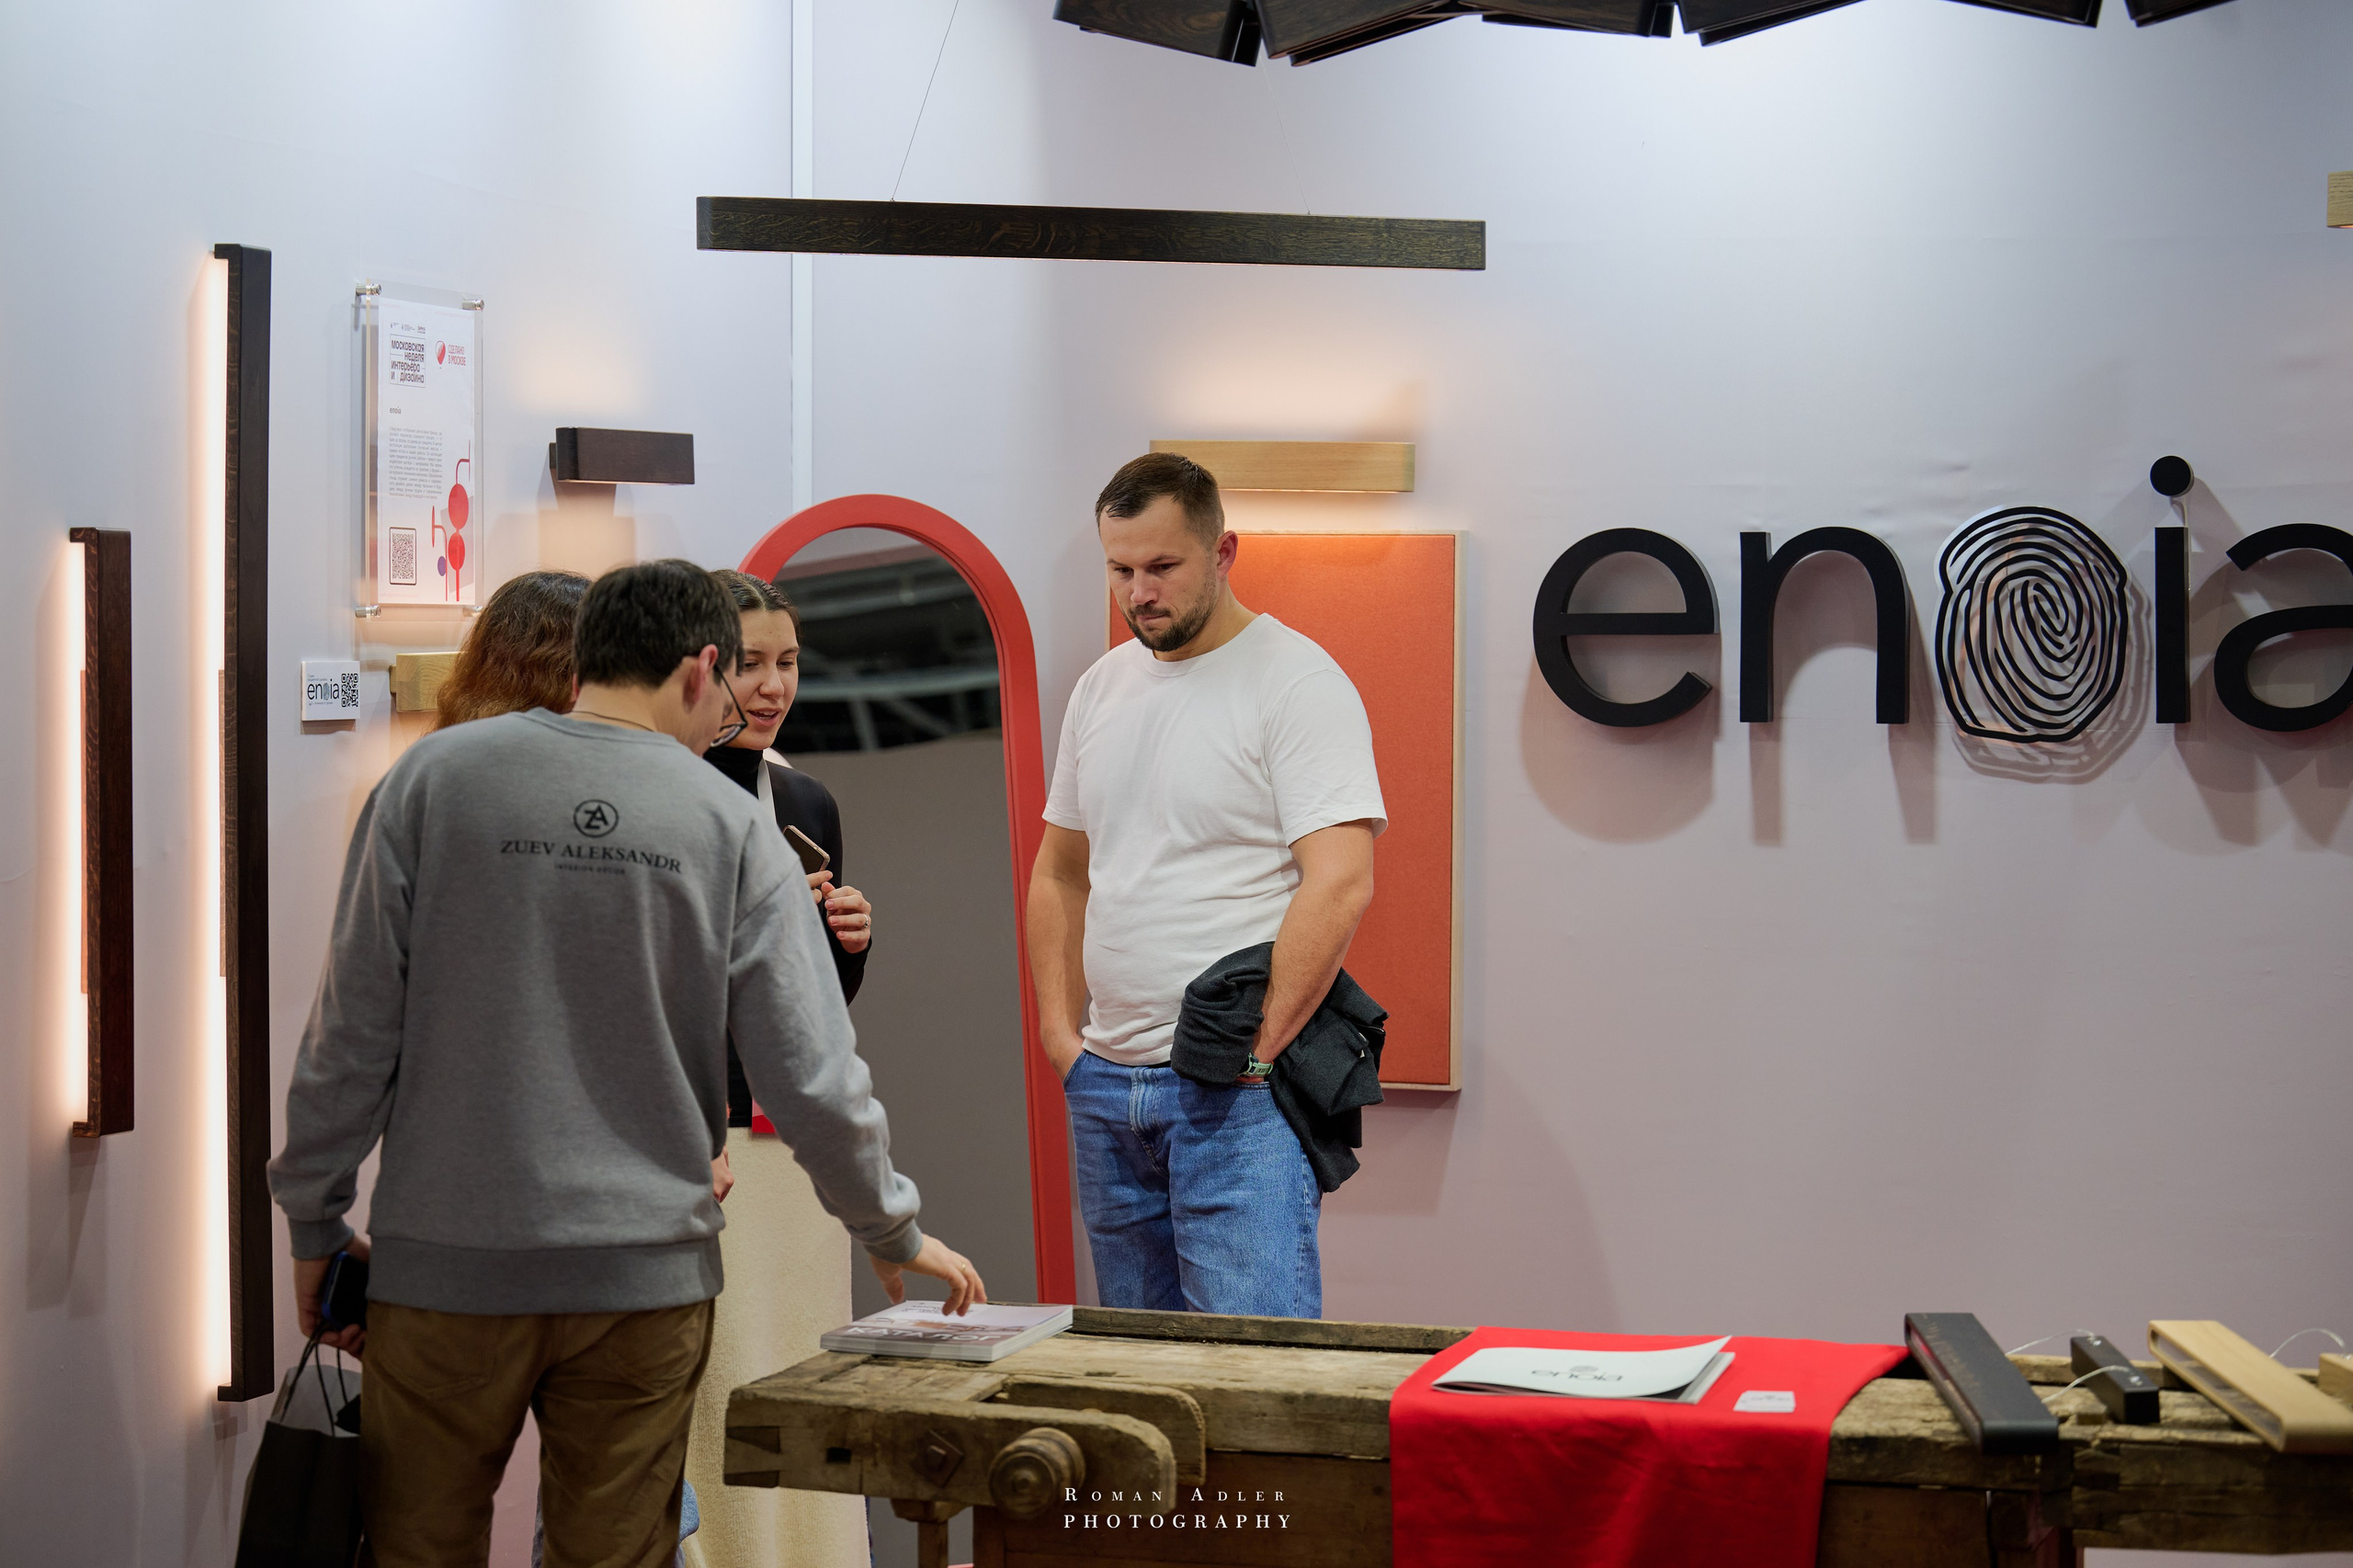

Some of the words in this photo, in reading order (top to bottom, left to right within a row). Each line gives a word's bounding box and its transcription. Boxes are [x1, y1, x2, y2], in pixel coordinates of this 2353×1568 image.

[448, 345, 464, 356] СДЕЛАНО
[451, 356, 466, 366] МОСКВЕ
[501, 840, 555, 855] ZUEV
[562, 844, 681, 873] ALEKSANDR
[844, 1326, 1002, 1341] КАТАЛОГ
